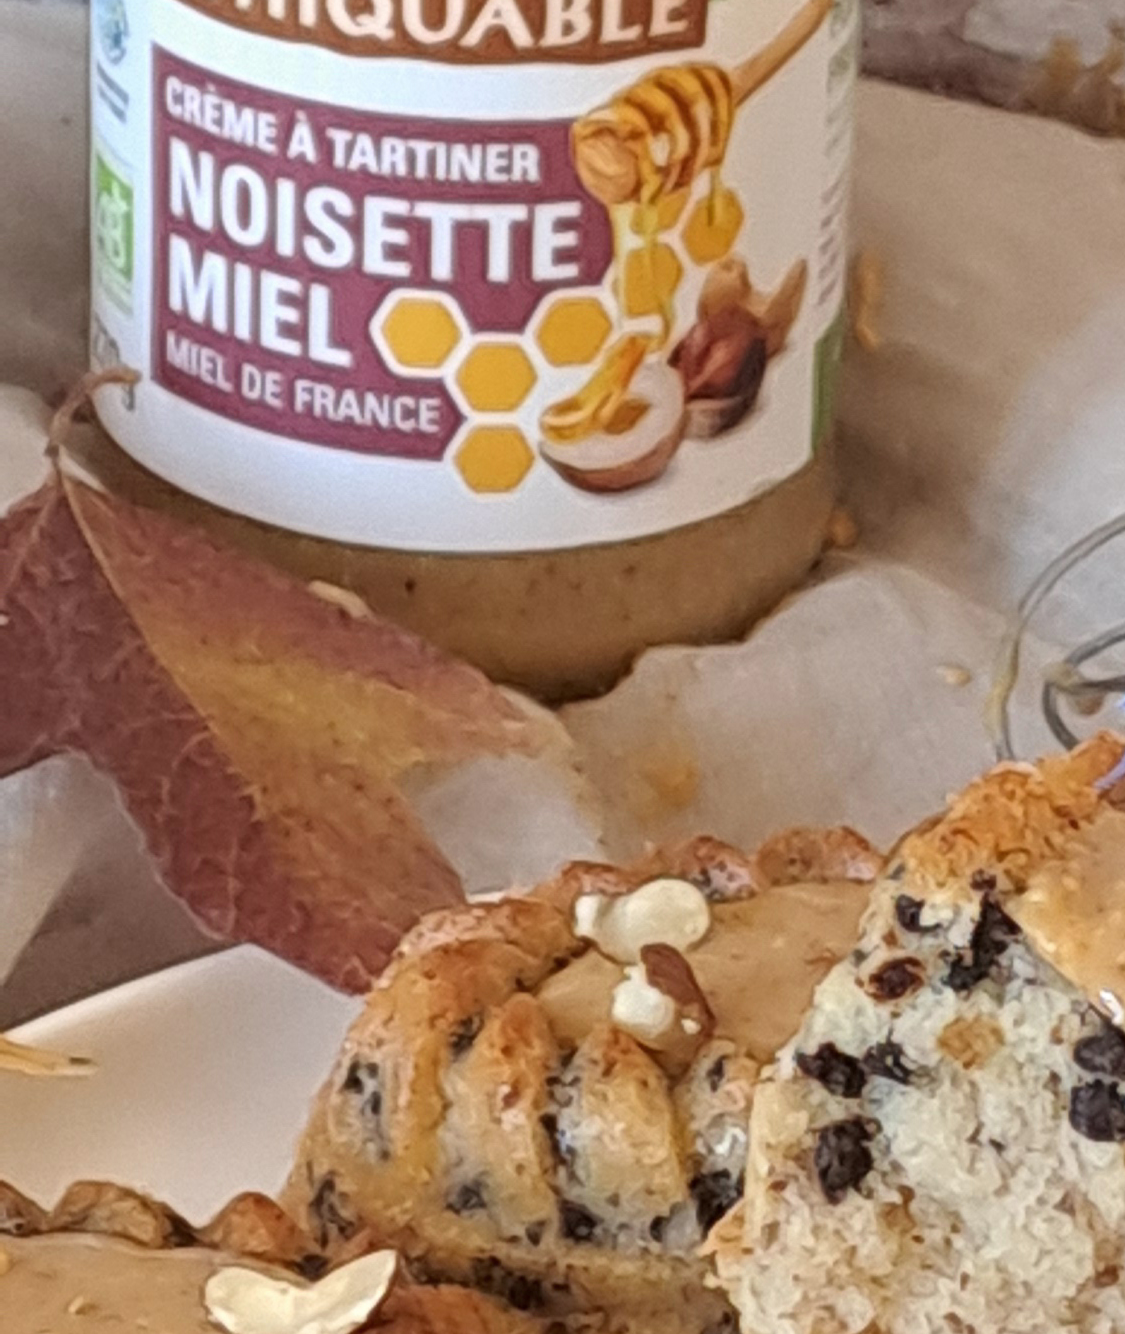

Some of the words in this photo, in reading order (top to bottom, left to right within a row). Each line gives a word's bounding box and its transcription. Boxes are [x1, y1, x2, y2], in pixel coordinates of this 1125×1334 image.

[165, 75, 276, 153] CRÈME
[287, 110, 317, 164] À
[326, 126, 539, 183] TARTINER
[169, 136, 582, 283] NOISETTE
[169, 232, 353, 369] MIEL
[166, 328, 233, 394] MIEL
[241, 363, 284, 410] DE
[293, 379, 442, 434] FRANCE
